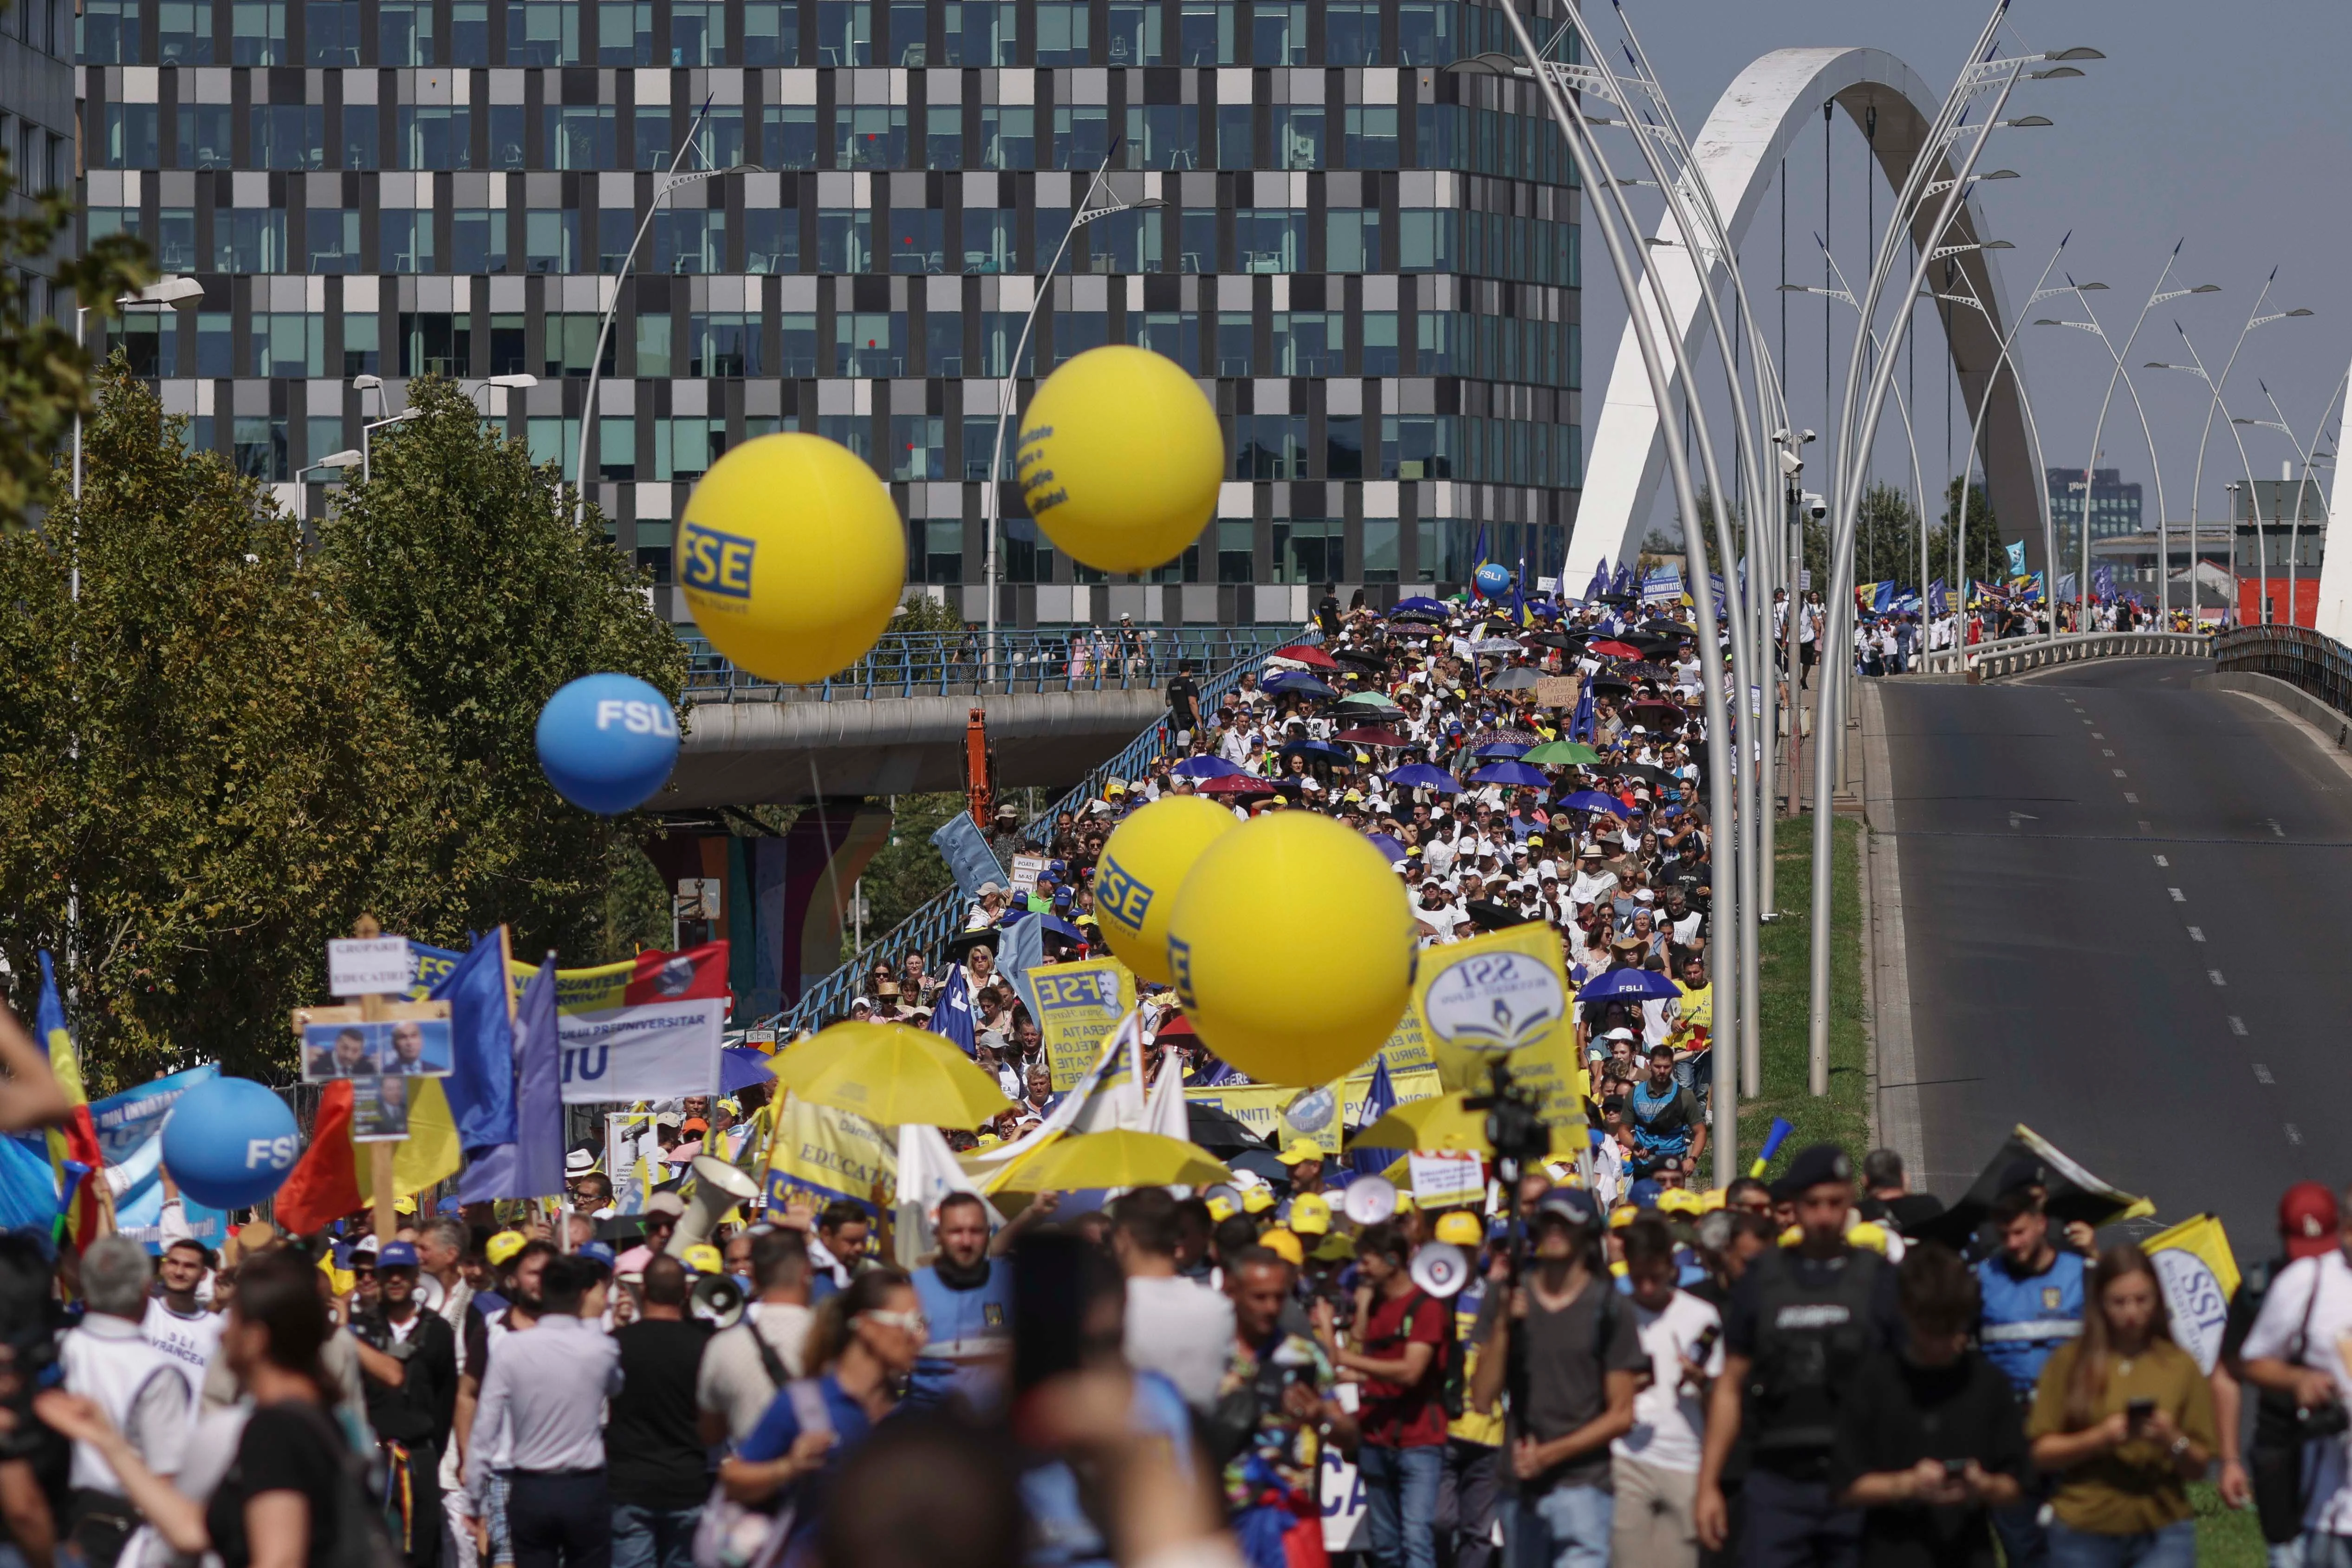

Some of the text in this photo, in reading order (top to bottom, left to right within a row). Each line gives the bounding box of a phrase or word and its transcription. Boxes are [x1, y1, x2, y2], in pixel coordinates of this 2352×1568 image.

[1479, 570, 1501, 581] FSLI
[1098, 861, 1149, 923] FSE
[419, 956, 455, 980] FS
[624, 1119, 647, 1136] SOCIETATE
[1228, 1107, 1270, 1125] UNIȚI
[2182, 1271, 2227, 1331] SSI
[152, 1336, 204, 1366] VRANCEA
